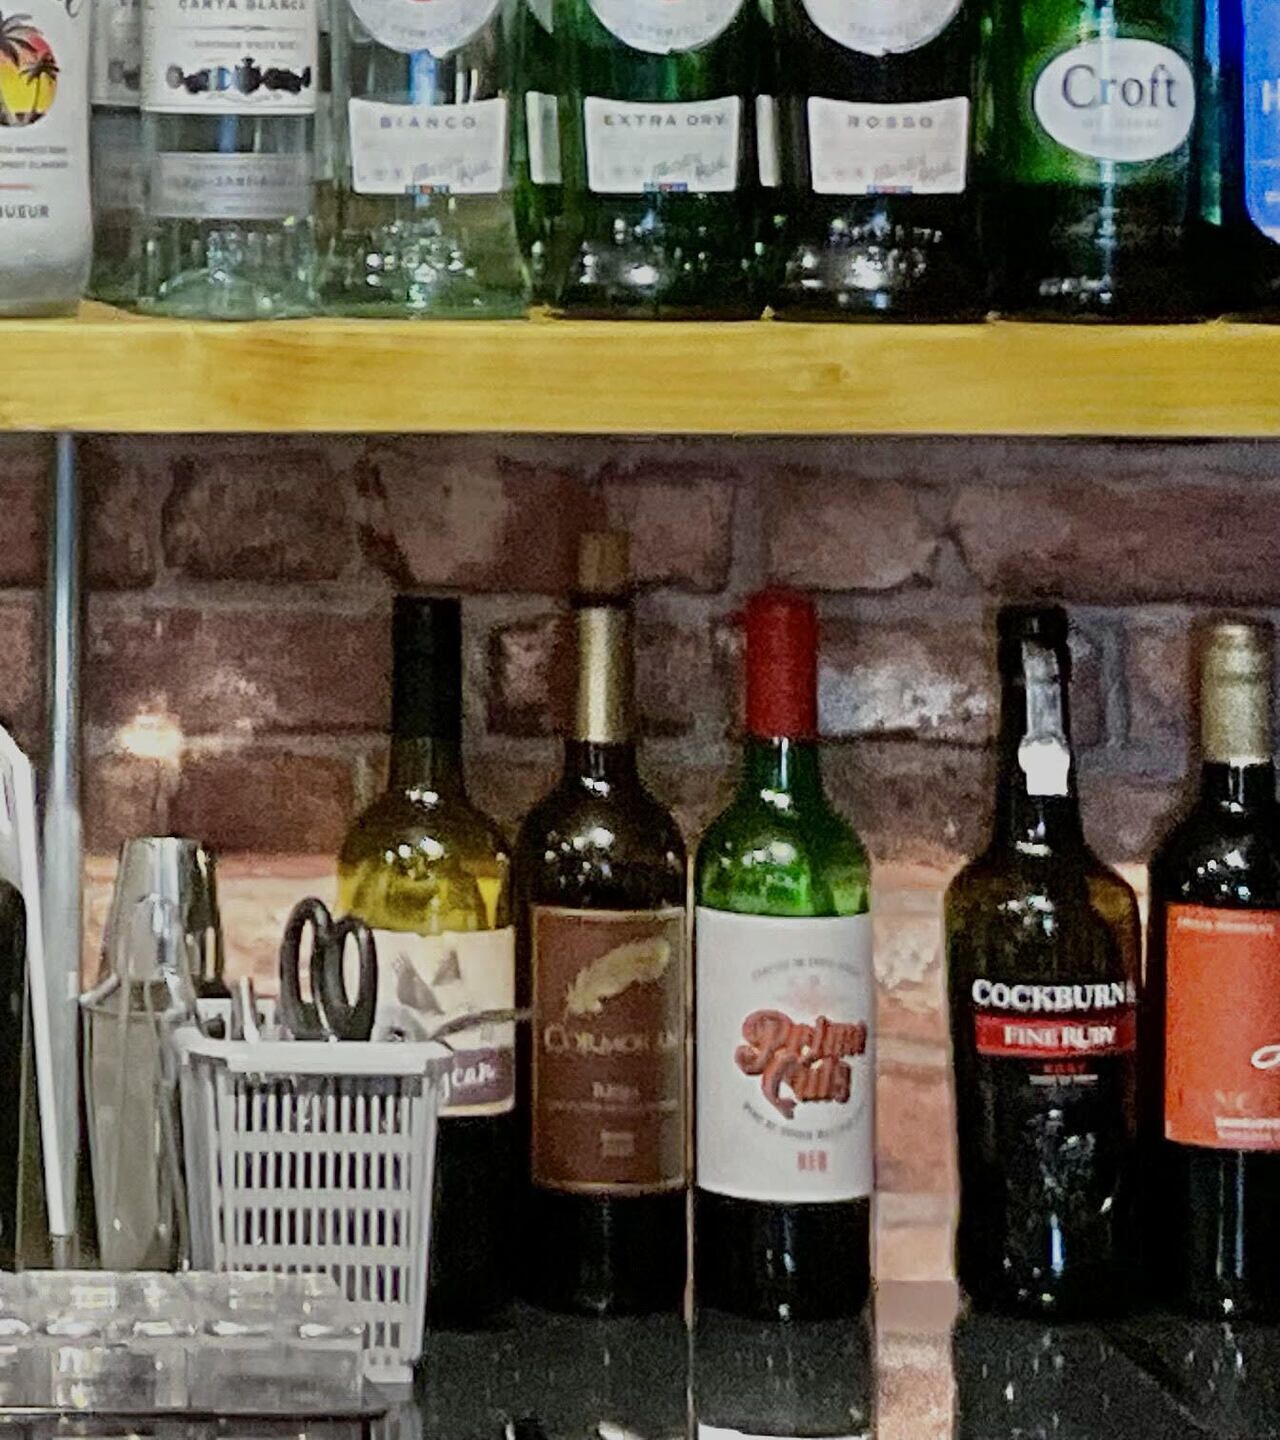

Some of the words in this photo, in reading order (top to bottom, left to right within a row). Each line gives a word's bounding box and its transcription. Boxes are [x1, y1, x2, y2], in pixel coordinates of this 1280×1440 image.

[1062, 62, 1179, 110] Croft
[379, 115, 478, 130] BIANCO
[685, 113, 725, 127] DRY
[845, 114, 934, 130] ROSSO
[1003, 1024, 1059, 1047] FINE
[1061, 1025, 1117, 1050] RUBY
